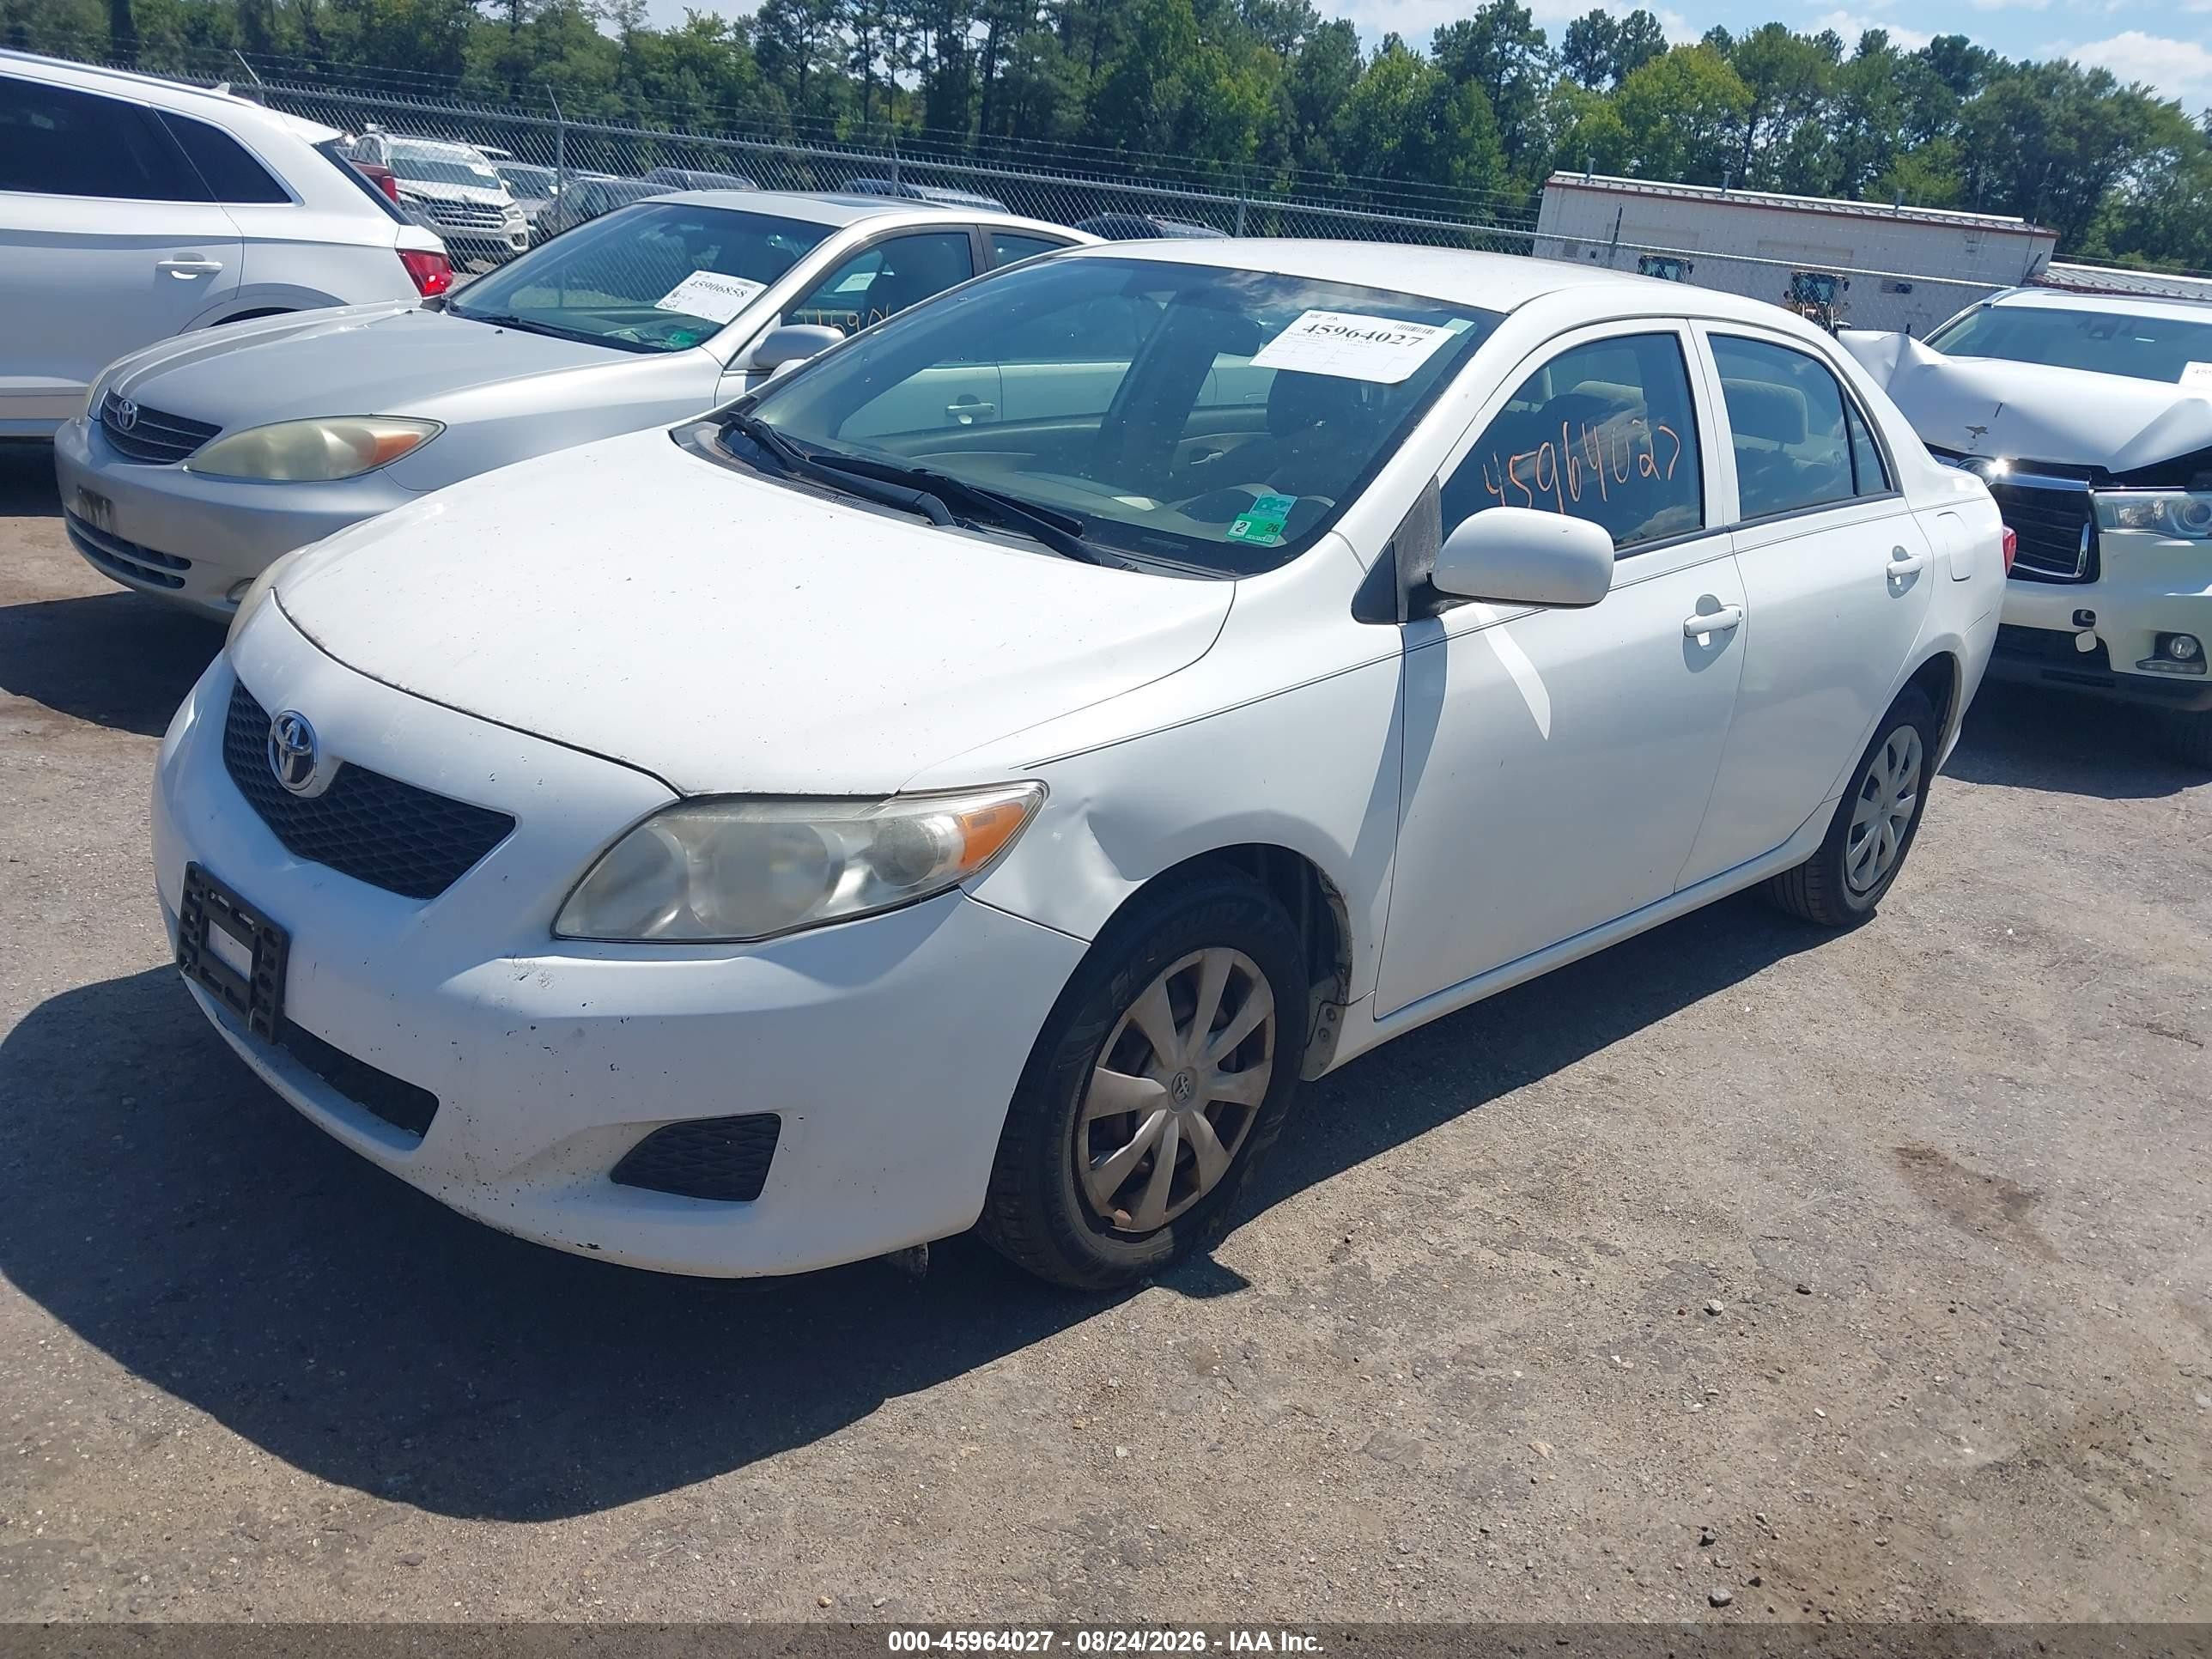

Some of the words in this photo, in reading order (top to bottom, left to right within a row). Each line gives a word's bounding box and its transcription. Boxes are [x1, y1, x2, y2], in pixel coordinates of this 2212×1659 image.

[690, 280, 748, 299] 45906858
[1303, 323, 1425, 347] 45964027
[1482, 419, 1681, 515] 45964027
[1235, 521, 1248, 532] 2
[1265, 522, 1280, 533] 26
